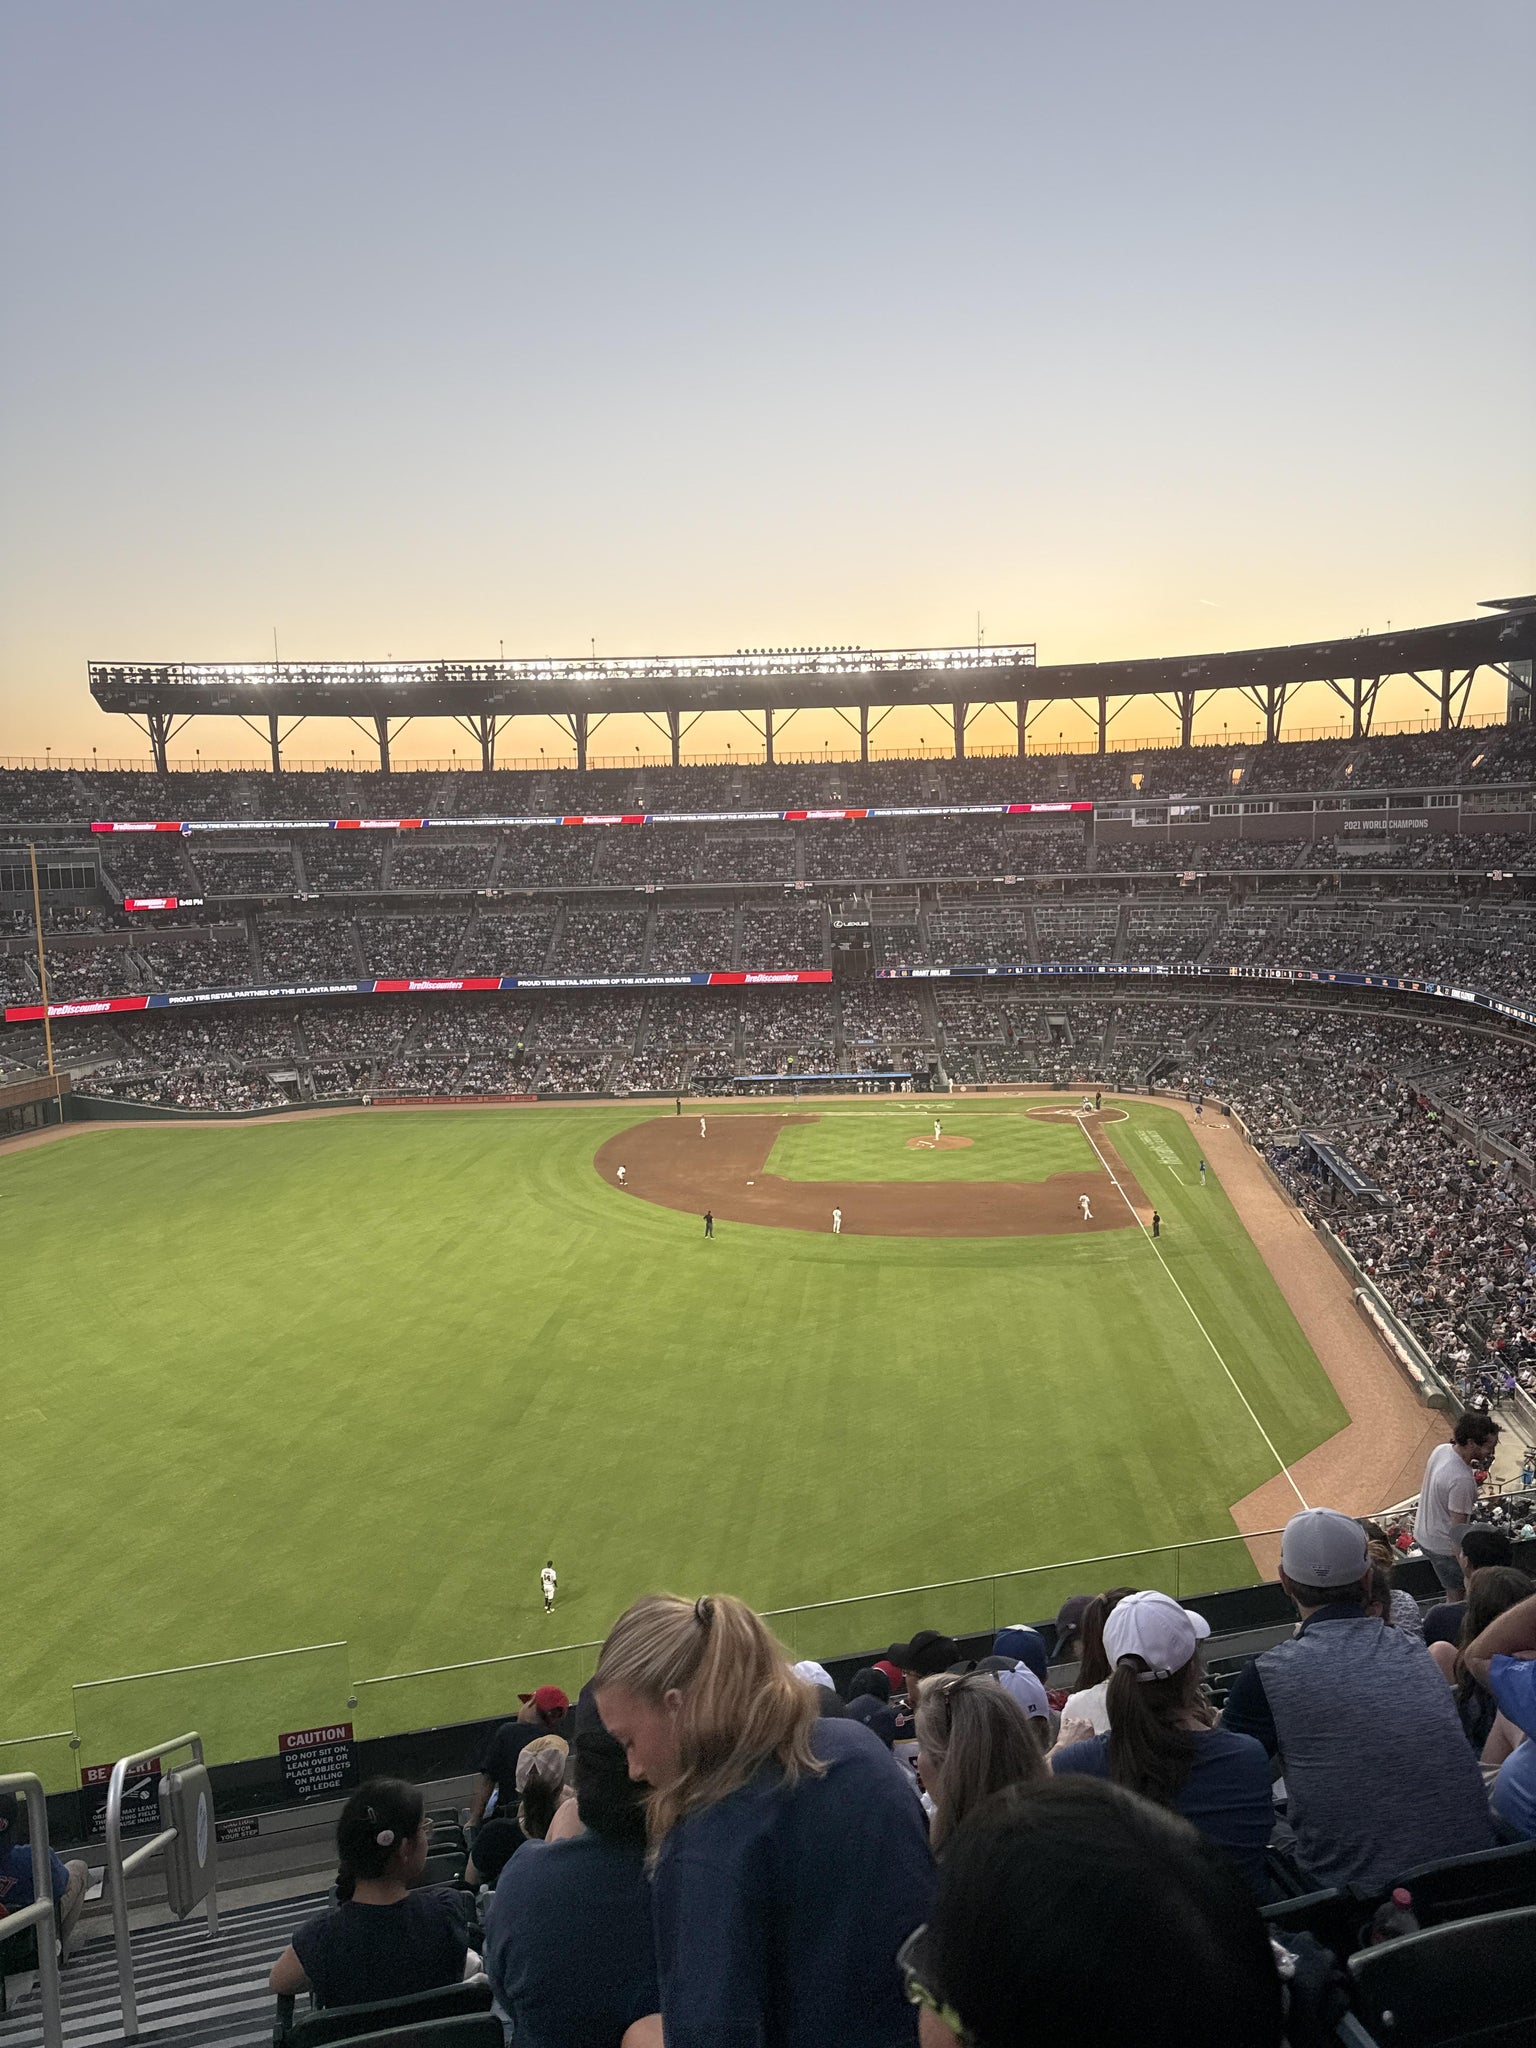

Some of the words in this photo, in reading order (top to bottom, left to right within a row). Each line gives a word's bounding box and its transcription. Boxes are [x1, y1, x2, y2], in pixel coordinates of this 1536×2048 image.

[1344, 821, 1360, 829] 2021
[1363, 820, 1387, 829] WORLD
[1388, 819, 1428, 829] CHAMPIONS
[745, 974, 798, 982] TireDiscounters
[409, 981, 463, 989] TireDiscounters
[287, 1727, 345, 1746] CAUTION
[300, 1751, 317, 1759] NOT
[288, 1761, 309, 1770] LEAN
[312, 1756, 333, 1765] OVER
[88, 1768, 107, 1781] BE
[286, 1769, 312, 1778] PLACE
[315, 1762, 351, 1773] OBJECTS
[310, 1772, 343, 1782] RAILING
[314, 1780, 340, 1790] LEDGE
[138, 1815, 160, 1823] INJURY
